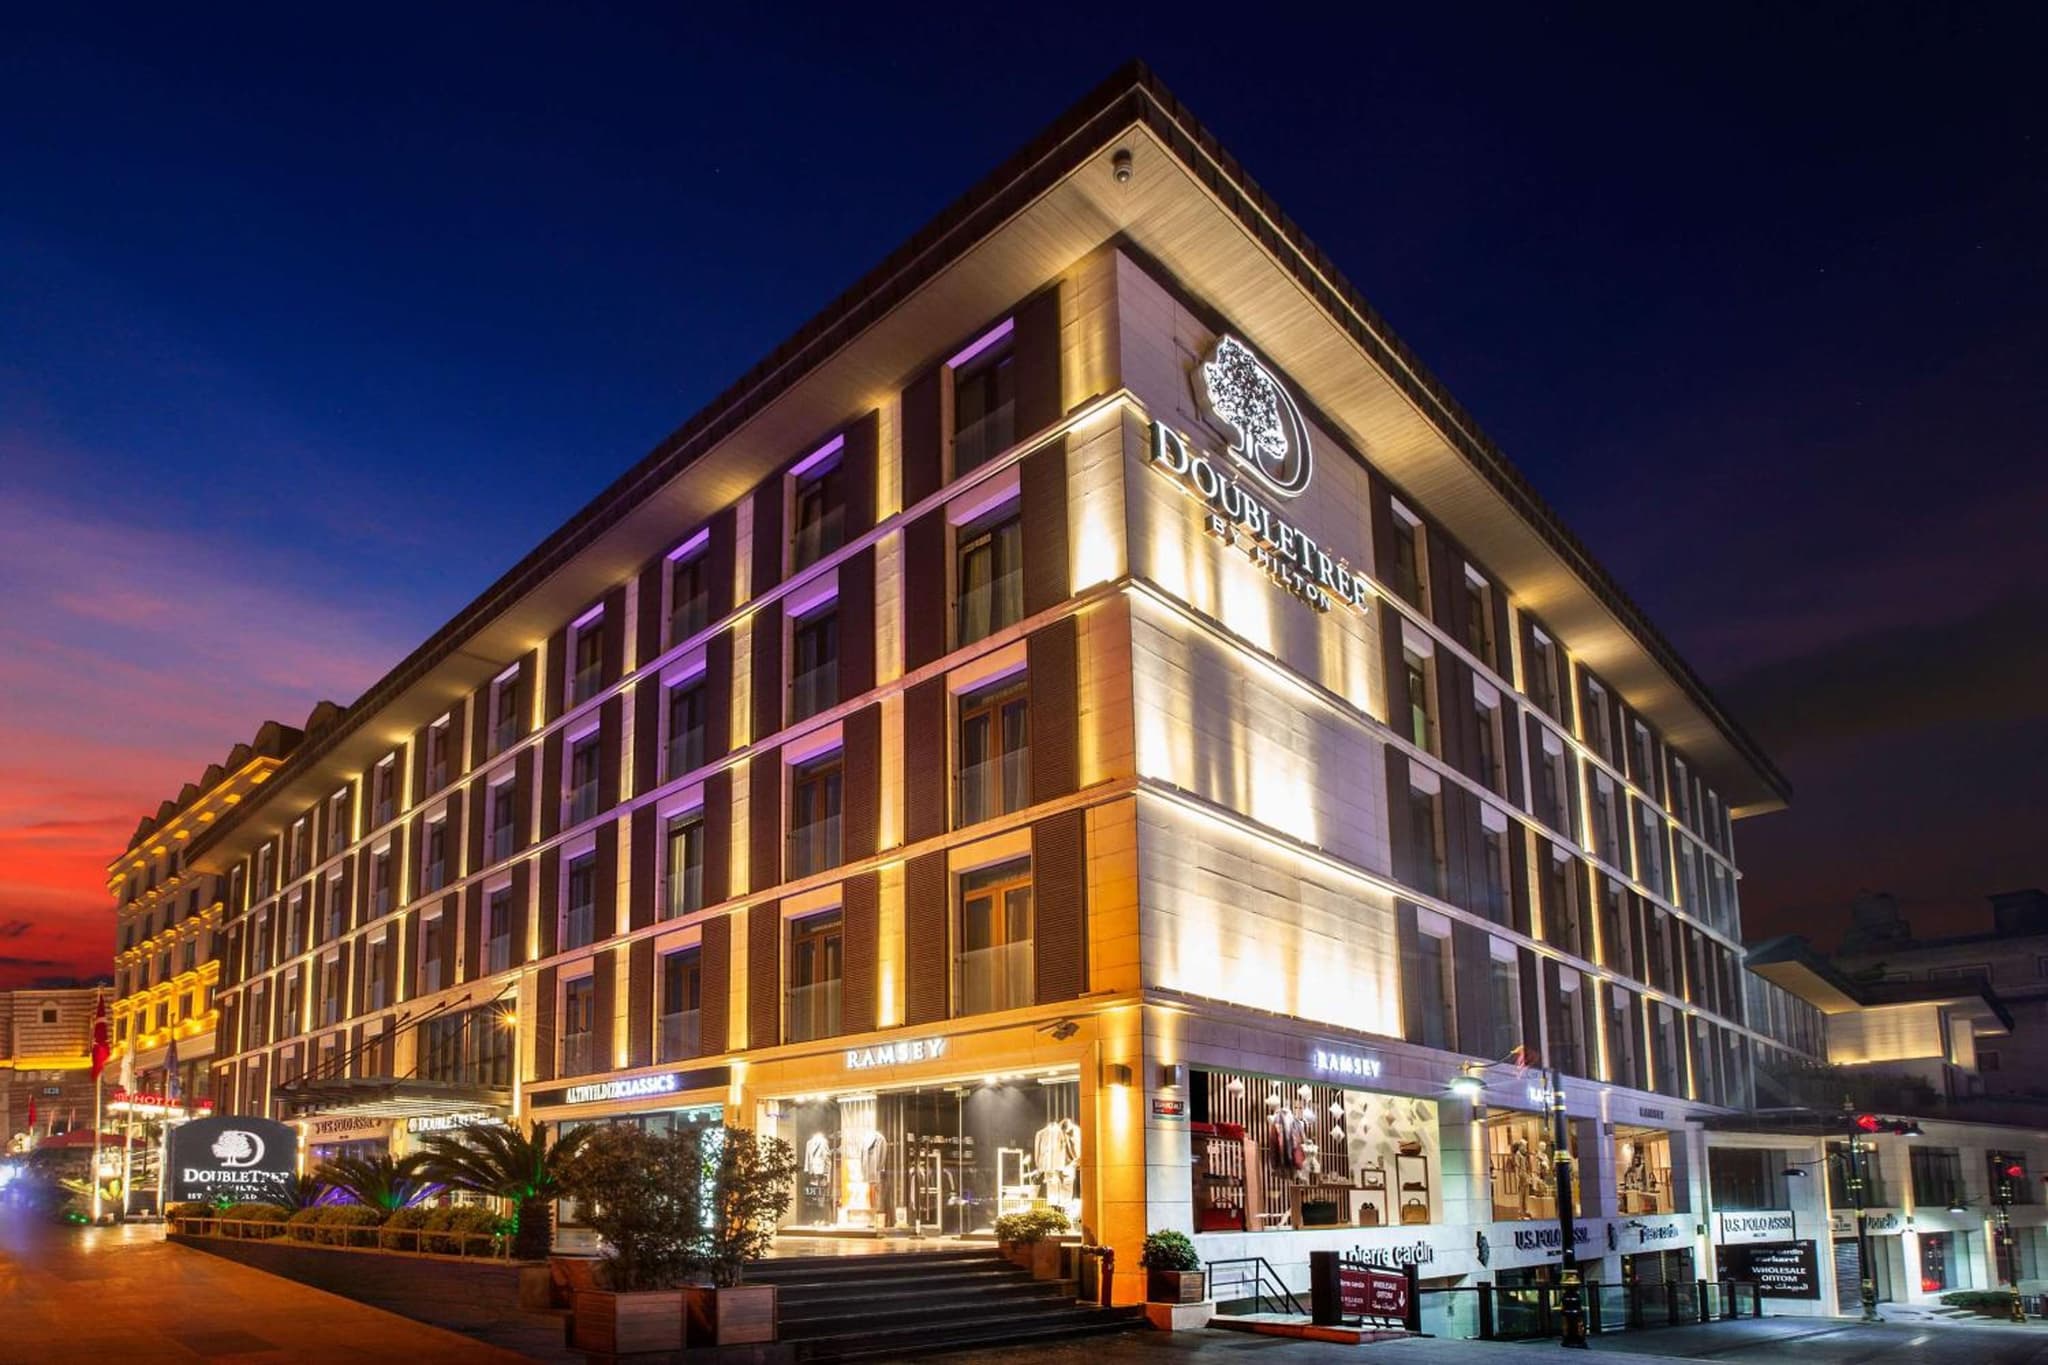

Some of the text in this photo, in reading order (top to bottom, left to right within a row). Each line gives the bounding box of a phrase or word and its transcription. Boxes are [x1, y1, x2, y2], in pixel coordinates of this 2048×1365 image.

[1208, 514, 1333, 613] BY HILTON
[847, 1037, 945, 1070] RAMSEY
[1314, 1050, 1381, 1078] RAMSEY
[1392, 1241, 1434, 1266] cardin
[1752, 1266, 1807, 1275] WHOLESALE
